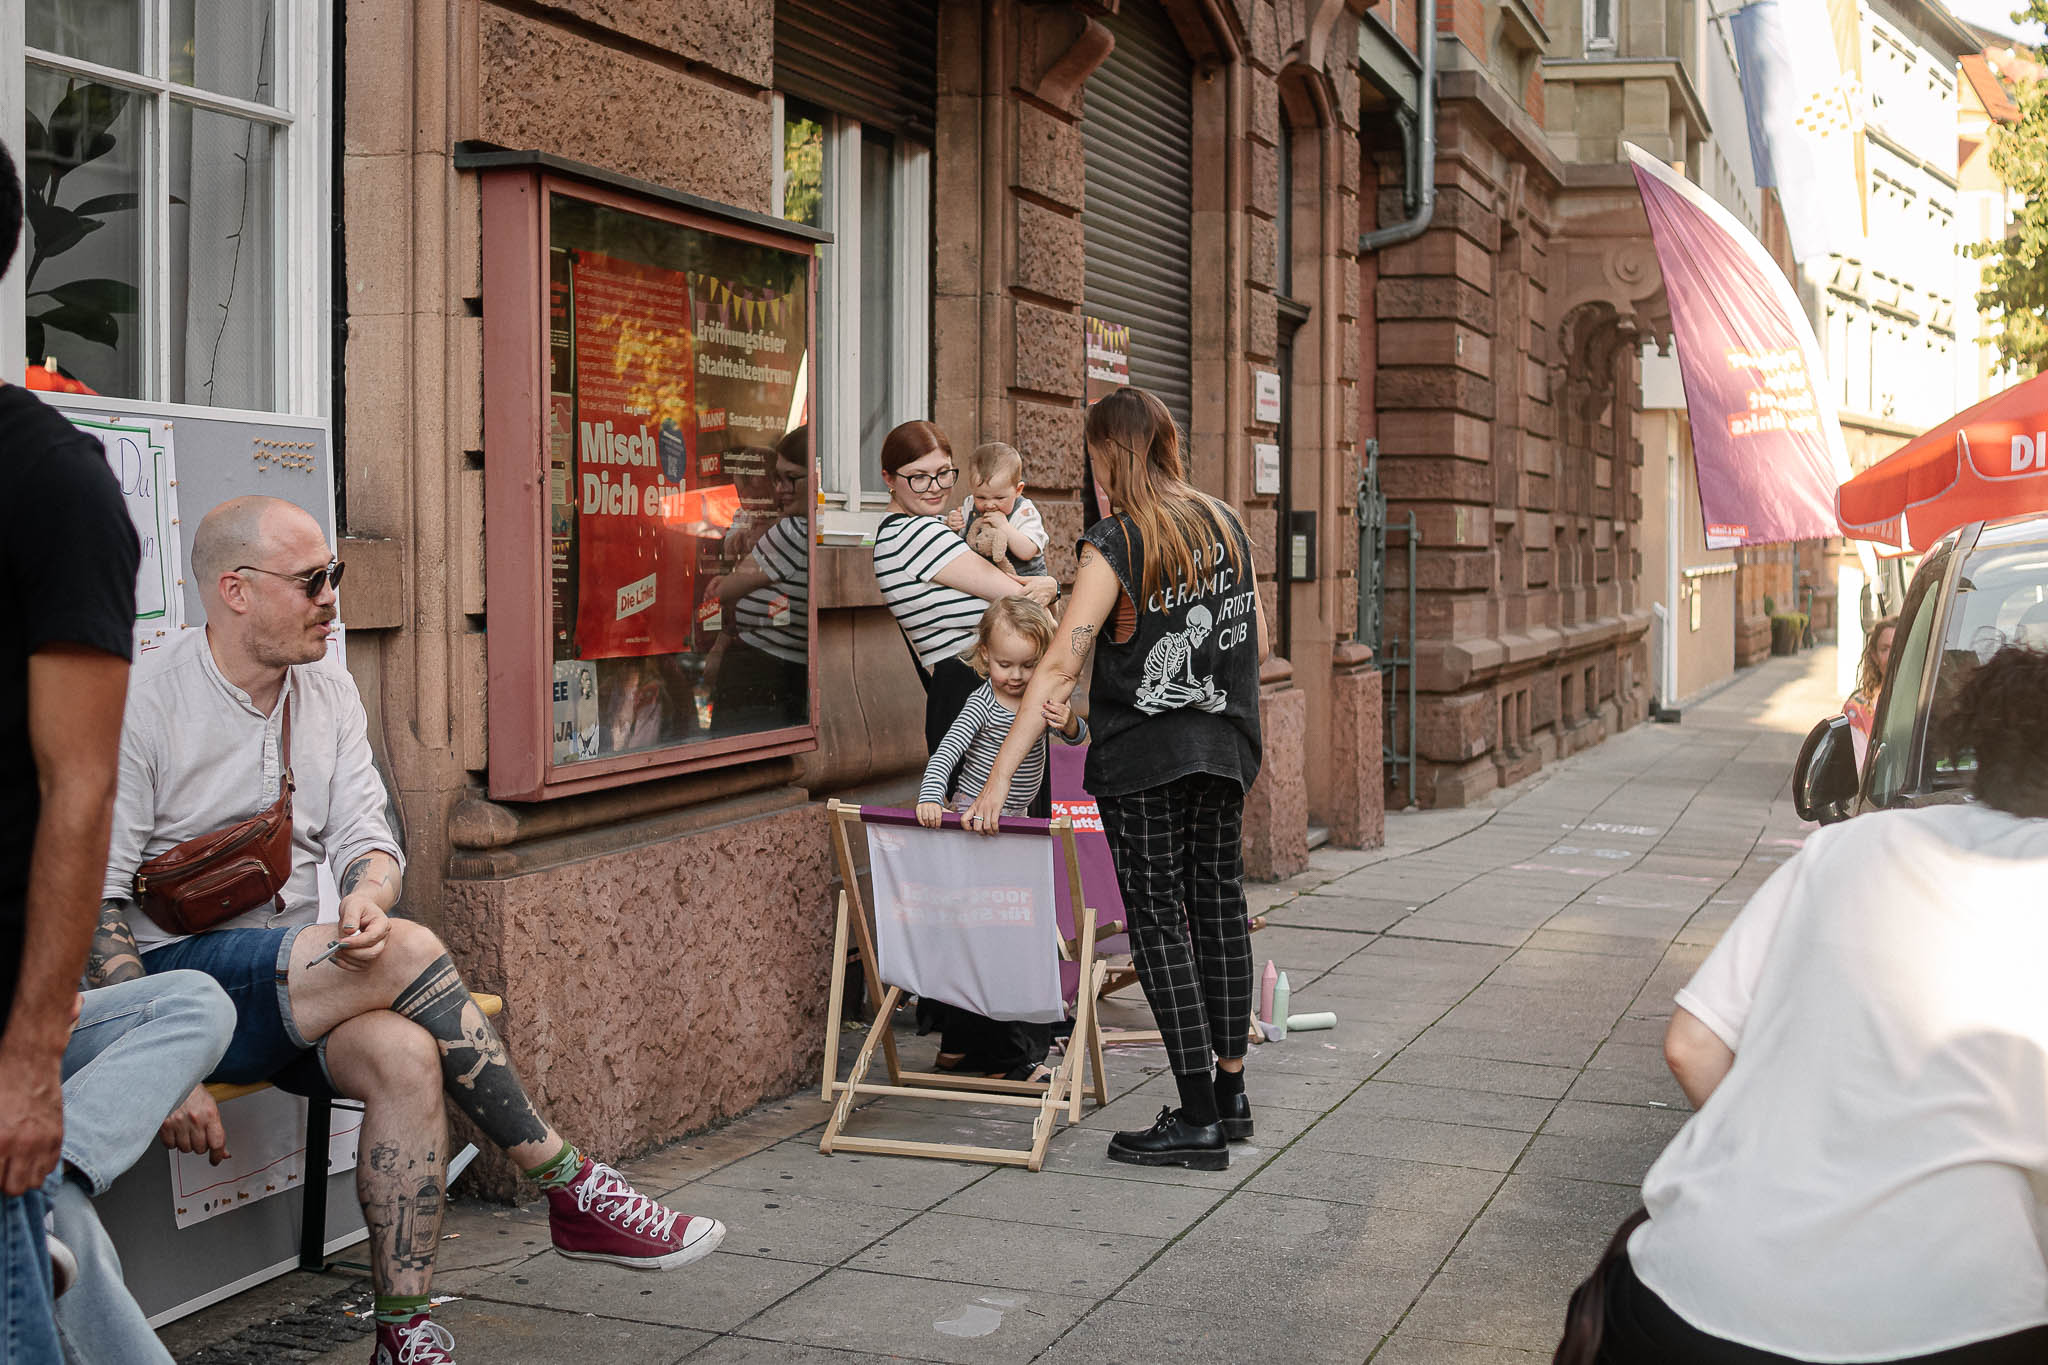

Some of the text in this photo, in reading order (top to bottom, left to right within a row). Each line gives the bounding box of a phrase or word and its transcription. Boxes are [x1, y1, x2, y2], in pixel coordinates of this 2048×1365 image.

[697, 319, 787, 355] Eröffnungsfeier
[698, 353, 792, 385] Stadtteilzentrum
[580, 420, 657, 467] Misch
[2010, 431, 2047, 473] DI
[117, 437, 151, 498] Du
[700, 456, 719, 473] WO?
[583, 470, 639, 516] Dich
[643, 473, 687, 517] ein!
[143, 536, 154, 559] in
[621, 592, 635, 612] Die
[1148, 567, 1234, 613] CERAMIC
[1218, 622, 1248, 651] CLUB
[553, 680, 569, 703] EE
[553, 720, 573, 743] JA
[1069, 802, 1100, 816] sozi
